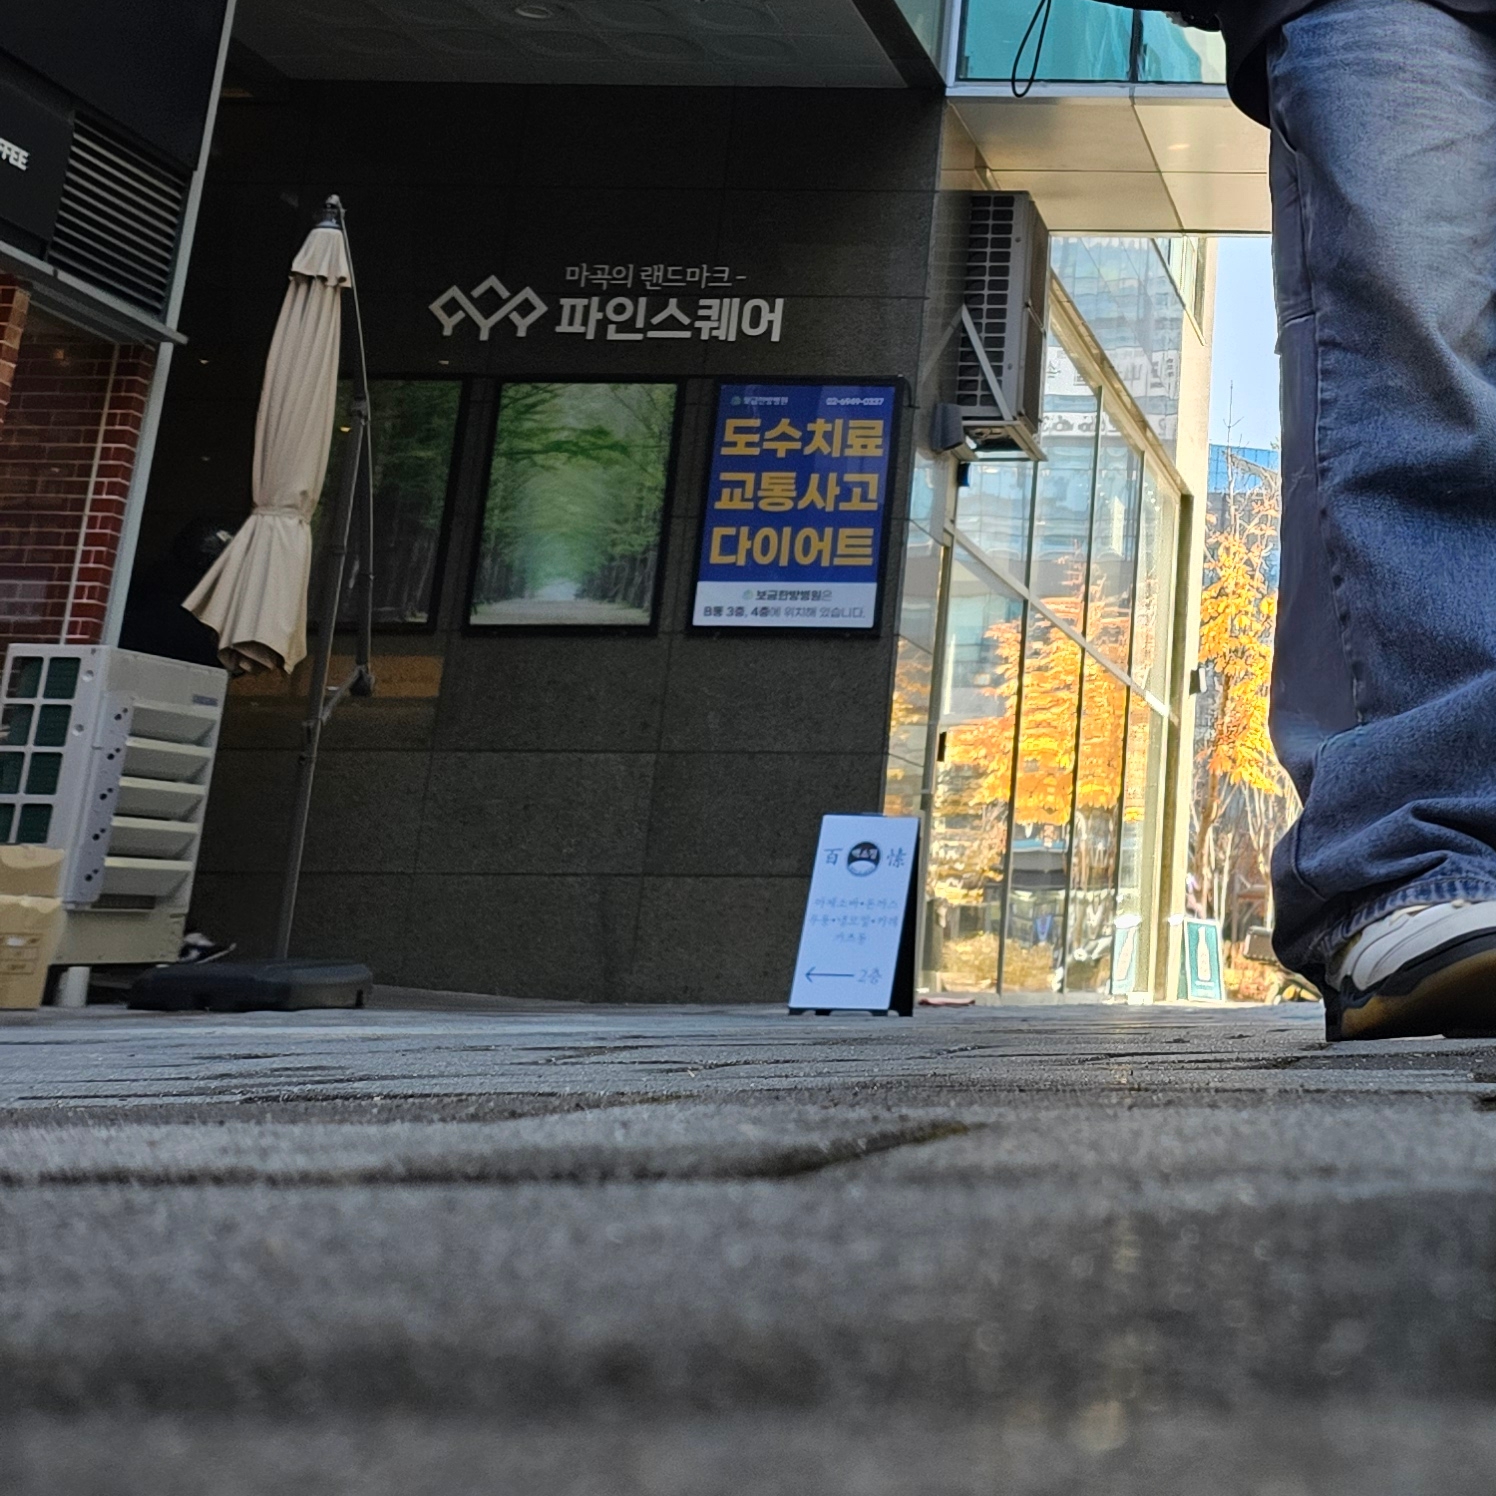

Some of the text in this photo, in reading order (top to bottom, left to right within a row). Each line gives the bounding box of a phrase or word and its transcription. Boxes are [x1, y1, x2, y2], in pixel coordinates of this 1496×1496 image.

[566, 263, 634, 290] 마곡의
[555, 297, 784, 342] 파인스퀘어
[720, 418, 884, 458] 도수치료
[713, 472, 879, 512] 교통사고
[709, 526, 875, 567] 다이어트
